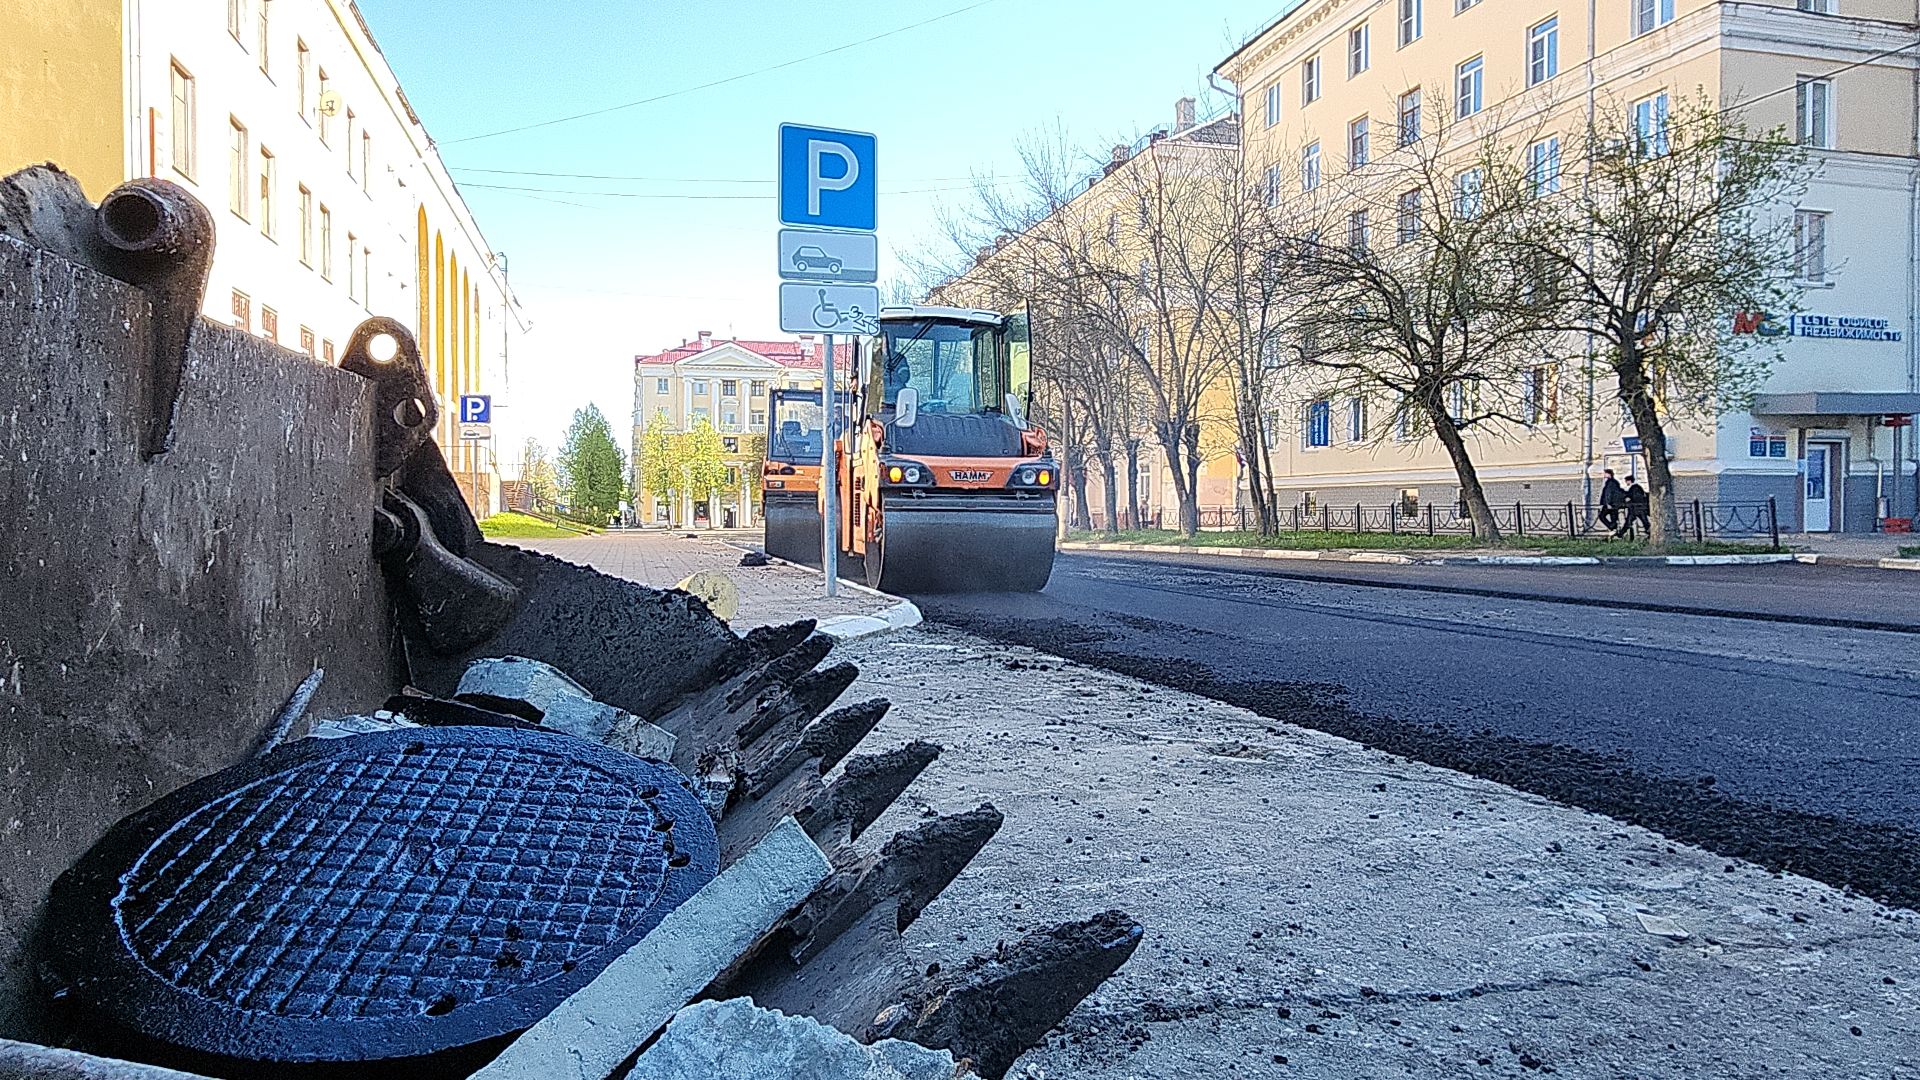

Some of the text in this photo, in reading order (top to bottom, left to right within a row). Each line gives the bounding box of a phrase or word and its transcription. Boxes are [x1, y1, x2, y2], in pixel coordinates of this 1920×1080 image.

[808, 139, 859, 216] P
[1804, 315, 1834, 327] СЕТЬ
[1804, 326, 1901, 341] НЕДВИЖИМОСТИ
[954, 471, 987, 480] HAMM
